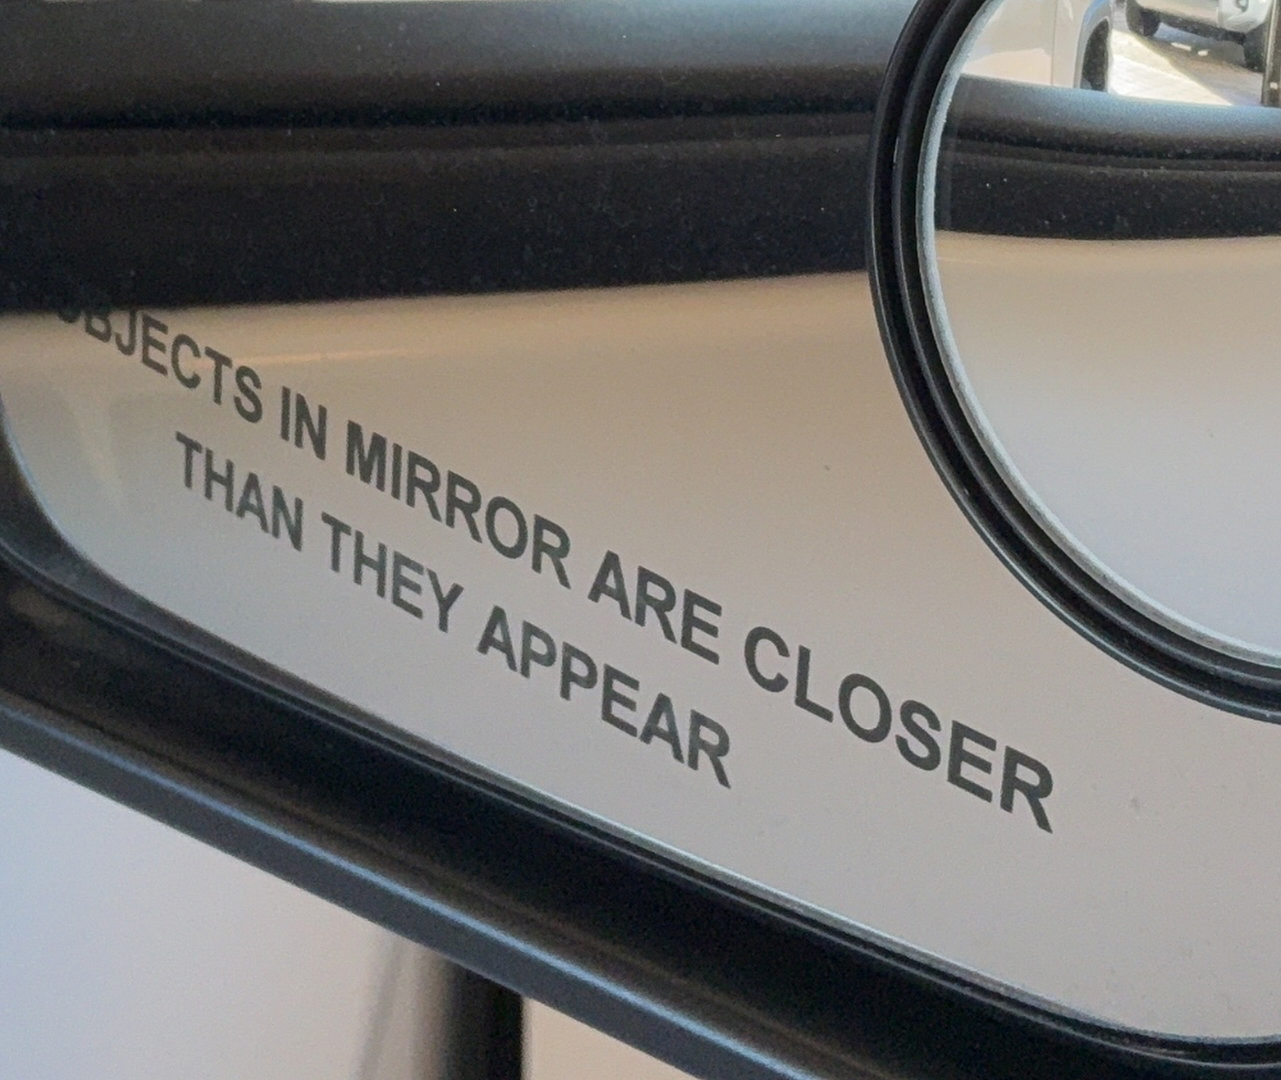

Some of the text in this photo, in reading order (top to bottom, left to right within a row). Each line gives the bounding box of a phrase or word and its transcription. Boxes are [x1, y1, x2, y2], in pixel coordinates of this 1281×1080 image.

[56, 308, 1054, 834] BJECTS IN MIRROR ARE CLOSER
[176, 431, 732, 790] THAN THEY APPEAR
